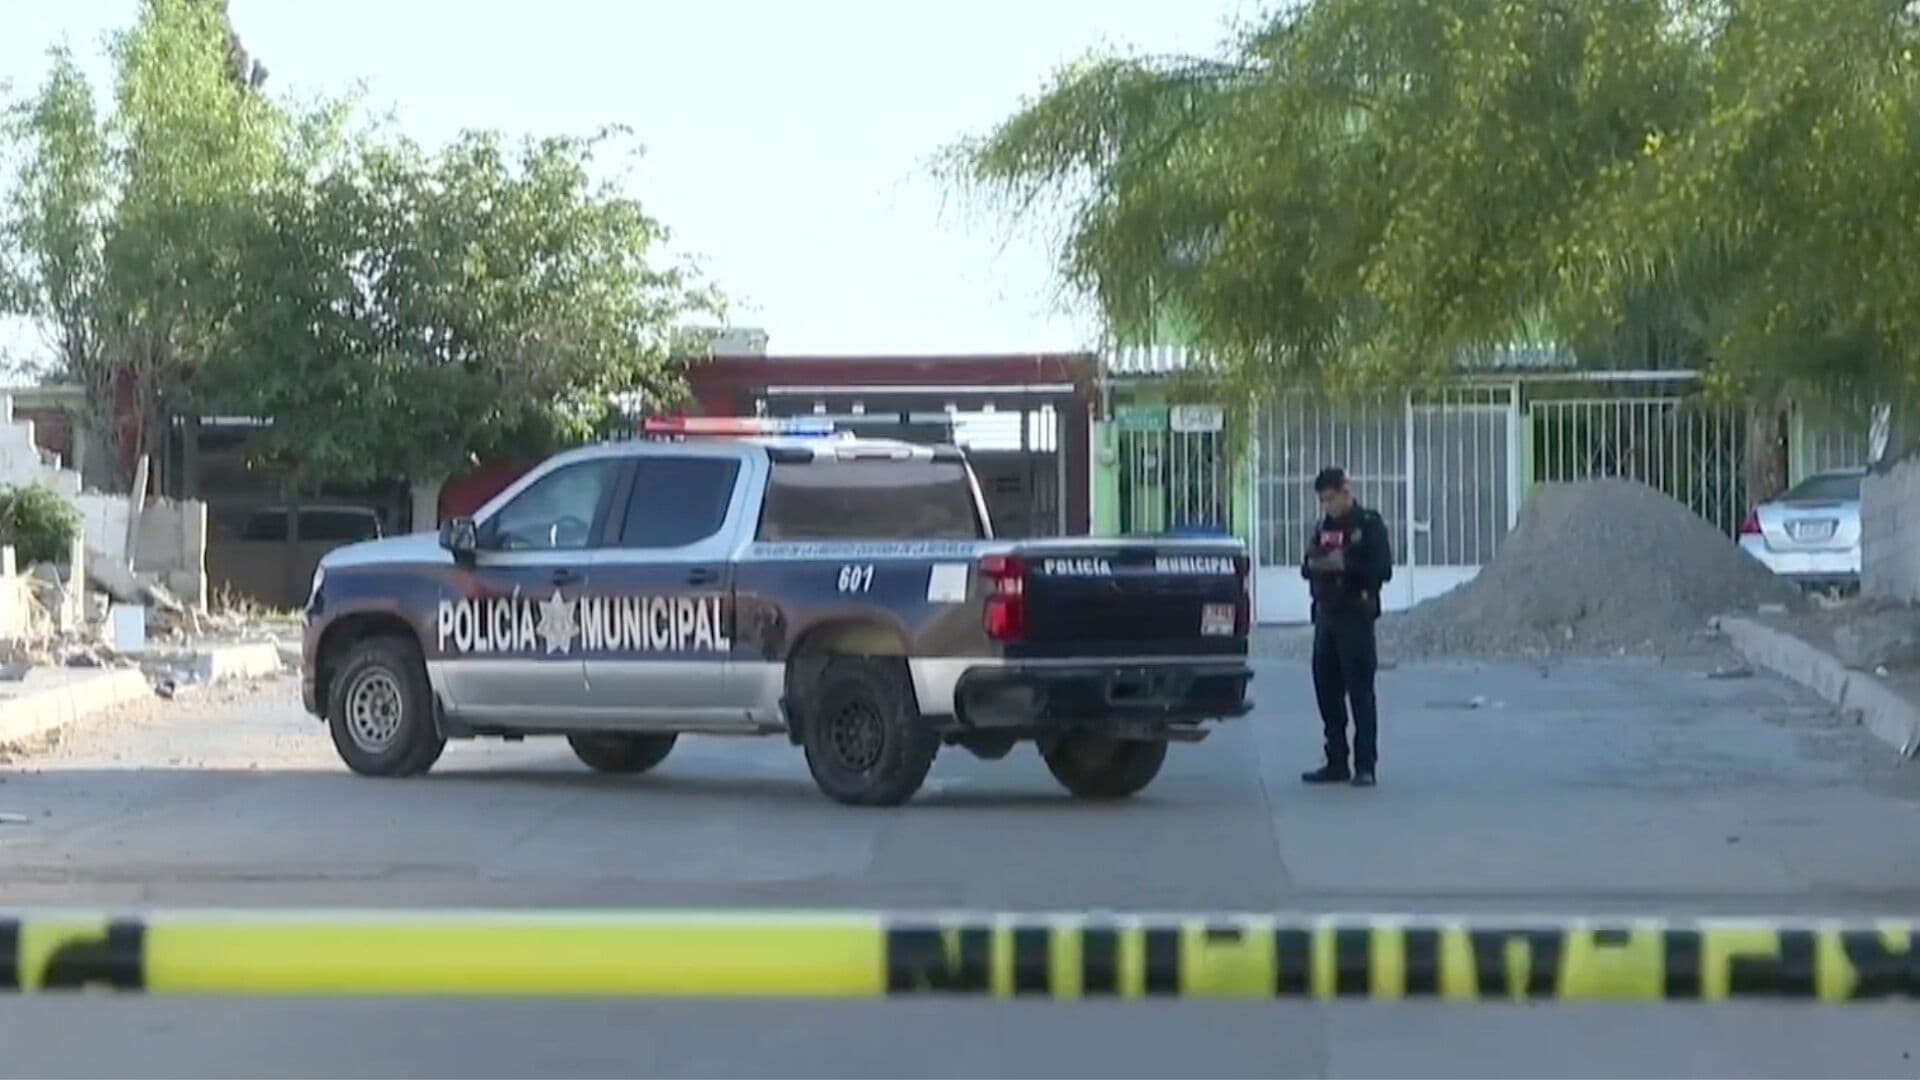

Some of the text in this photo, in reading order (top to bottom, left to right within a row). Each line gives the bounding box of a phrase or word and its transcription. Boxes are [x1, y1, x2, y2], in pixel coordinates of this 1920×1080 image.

[837, 563, 874, 592] 601
[1155, 556, 1235, 575] MUNICIPAL
[438, 584, 730, 651] POLICÍA MUNICIPAL
